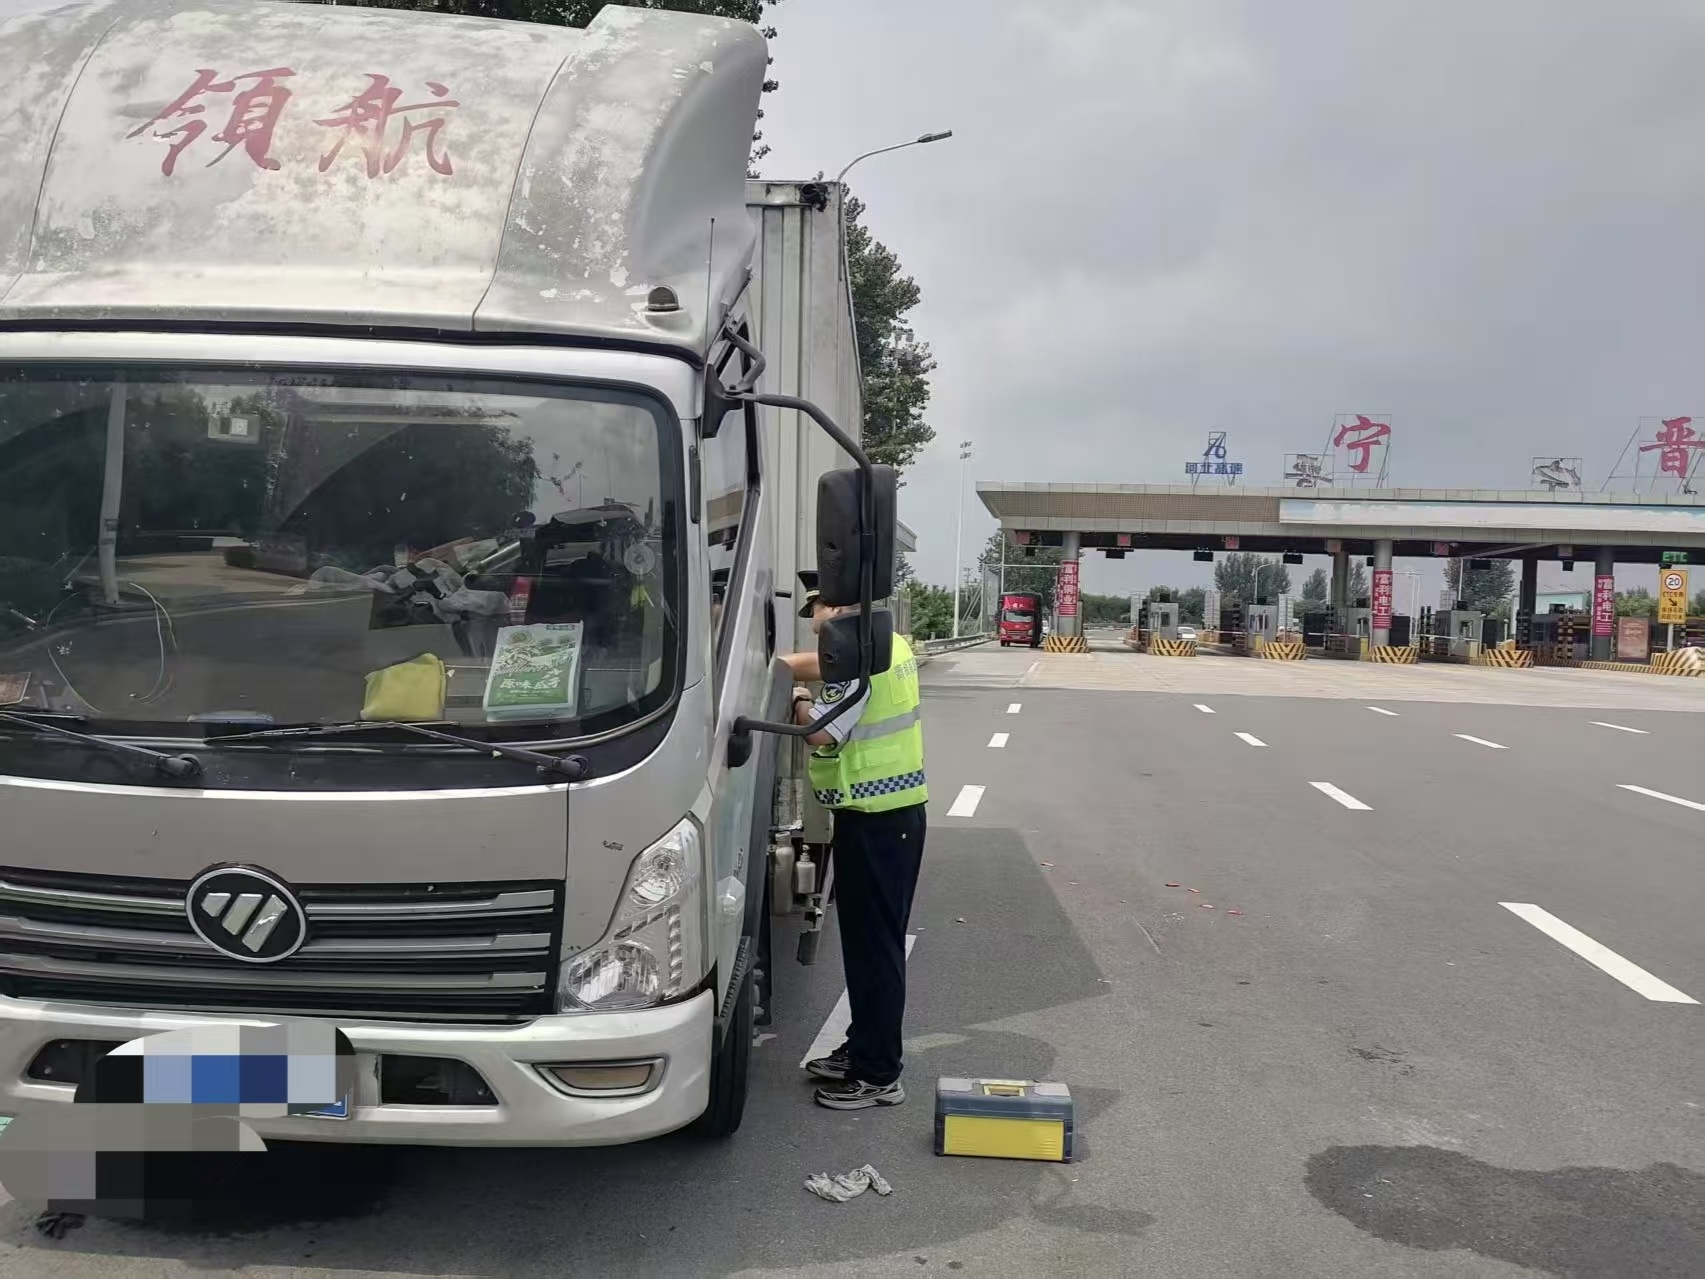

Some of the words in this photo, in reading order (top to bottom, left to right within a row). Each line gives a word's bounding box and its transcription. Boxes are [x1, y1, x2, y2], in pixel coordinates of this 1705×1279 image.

[1334, 414, 1391, 472] 宁
[1640, 416, 1705, 478] 晋
[1185, 463, 1242, 474] 河北高速
[1662, 551, 1688, 562] ETC
[1668, 577, 1680, 586] 20
